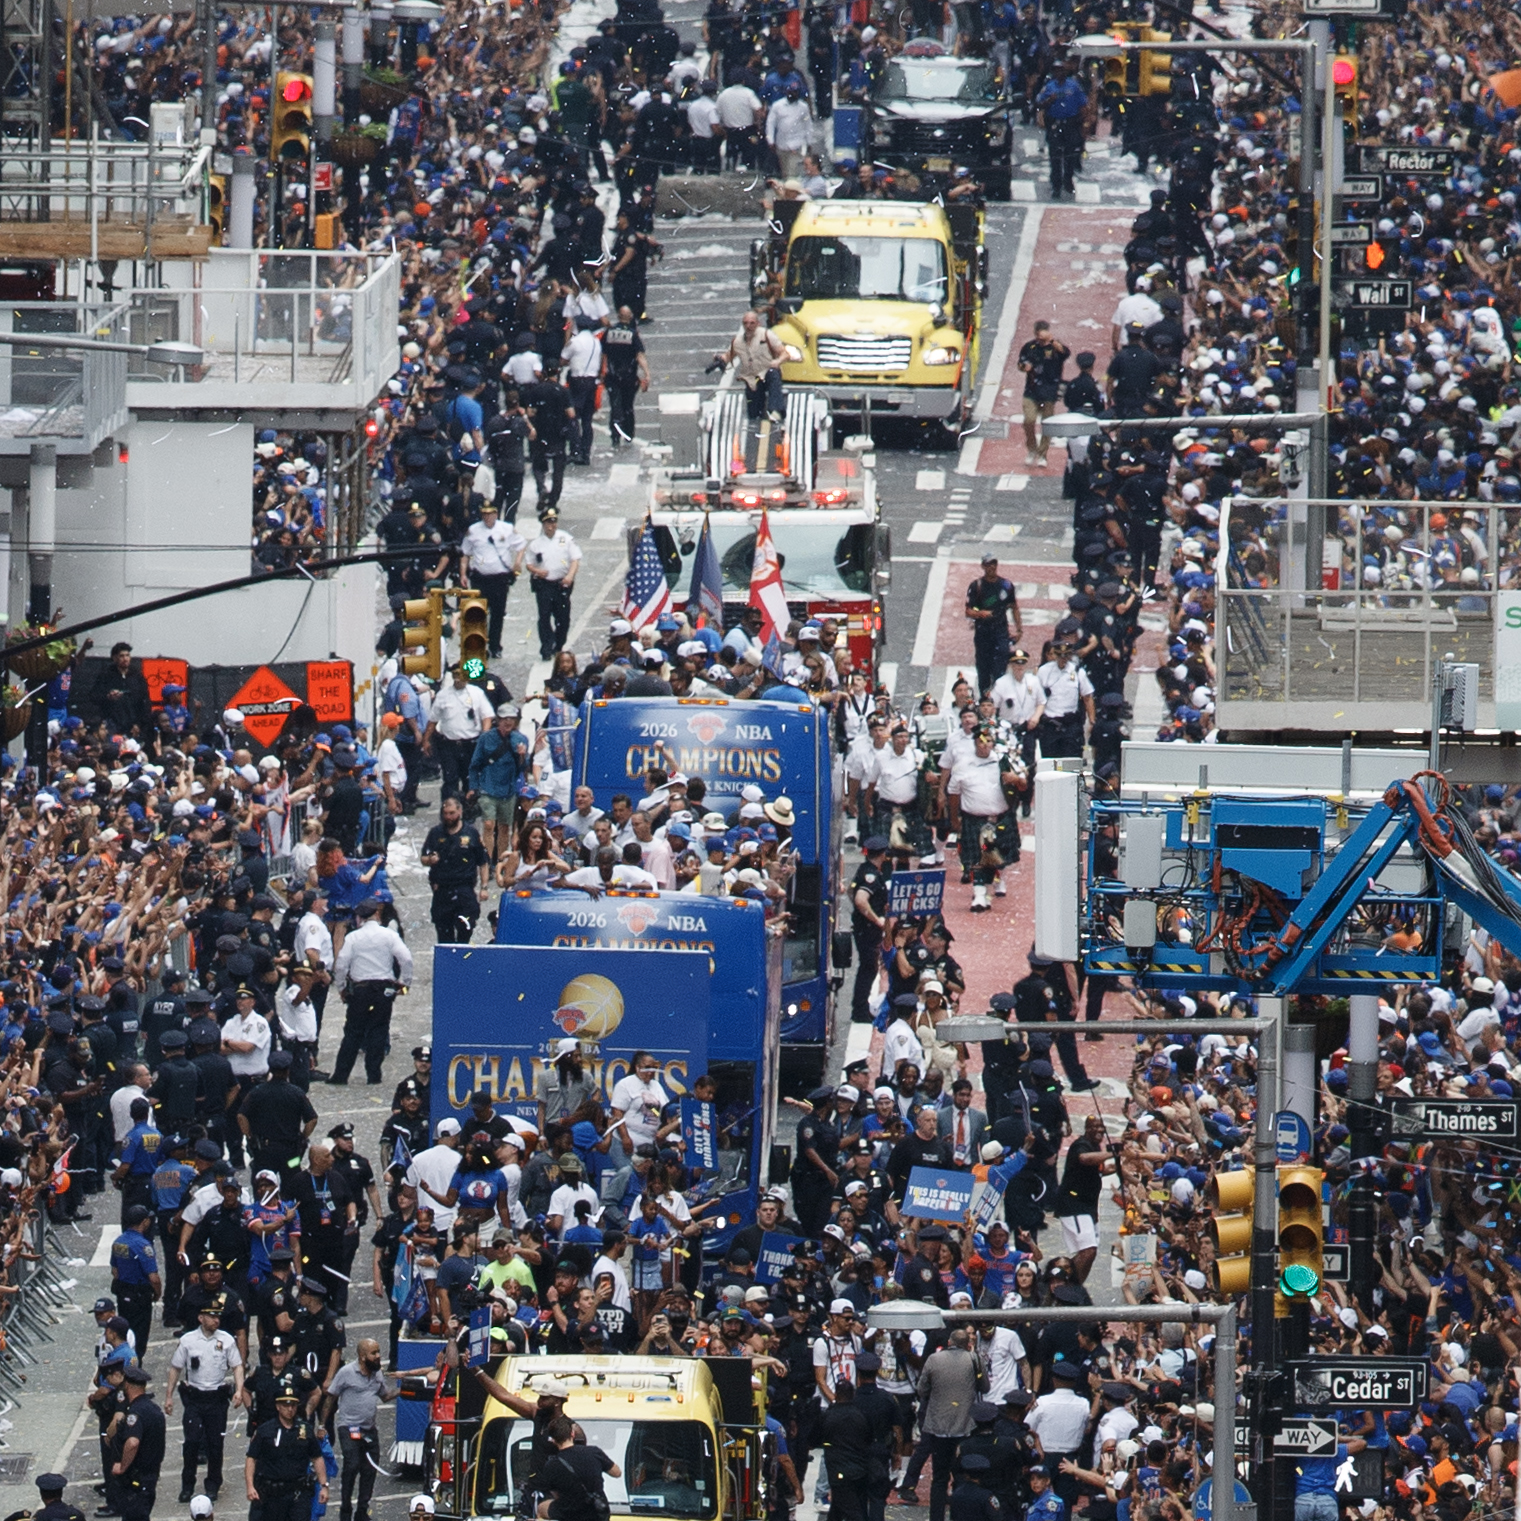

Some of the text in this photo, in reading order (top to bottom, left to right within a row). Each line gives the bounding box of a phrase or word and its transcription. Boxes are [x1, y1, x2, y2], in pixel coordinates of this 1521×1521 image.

[1390, 155, 1434, 170] Rector
[1358, 281, 1390, 304] Wall
[310, 668, 347, 681] SHARE
[318, 685, 340, 698] THE
[314, 703, 345, 716] ROAD
[640, 723, 773, 740] 2026 NBA
[625, 745, 782, 782] CHAMPIONS
[926, 882, 942, 898] GO
[567, 912, 708, 931] 2026 NBA
[1427, 1110, 1513, 1131] Thames ST
[762, 1250, 795, 1267] THANK
[1332, 1377, 1410, 1400] Cedar ST
[1287, 1431, 1322, 1445] WAY
